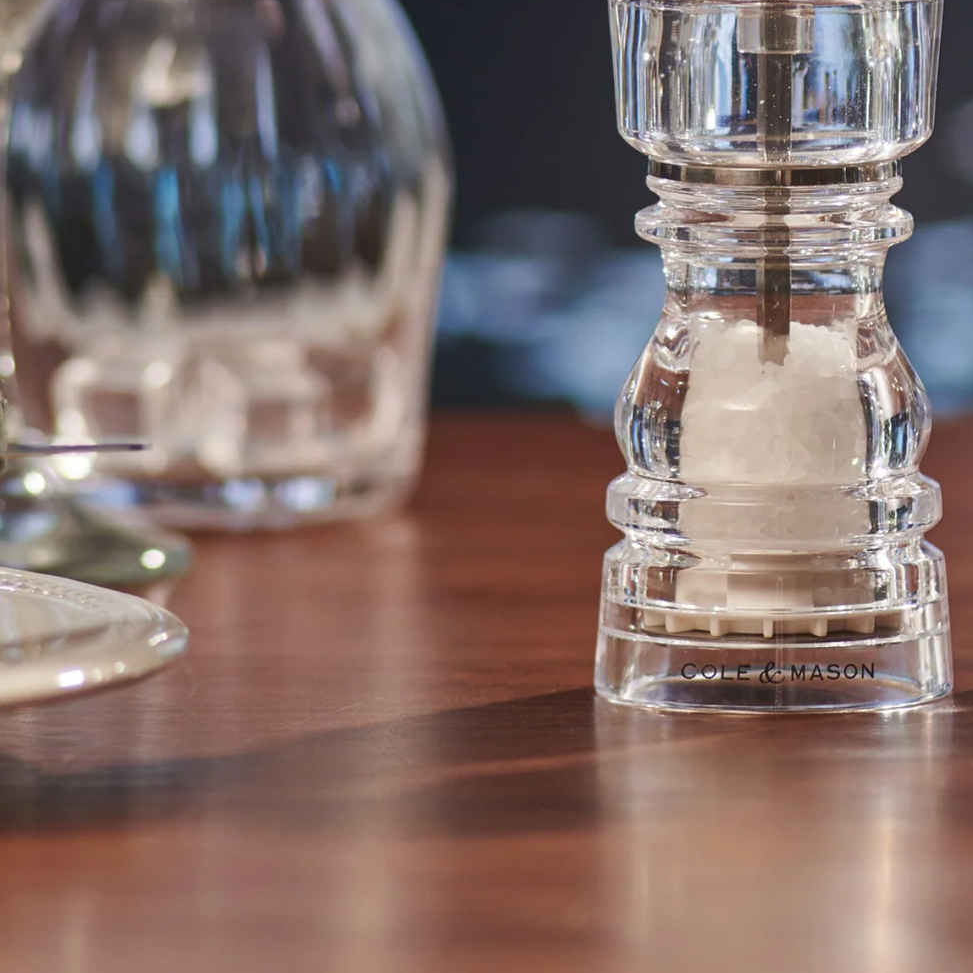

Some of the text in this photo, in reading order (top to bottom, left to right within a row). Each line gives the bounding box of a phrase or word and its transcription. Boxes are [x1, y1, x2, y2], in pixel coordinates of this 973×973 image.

[681, 661, 874, 684] COLE & MASON
